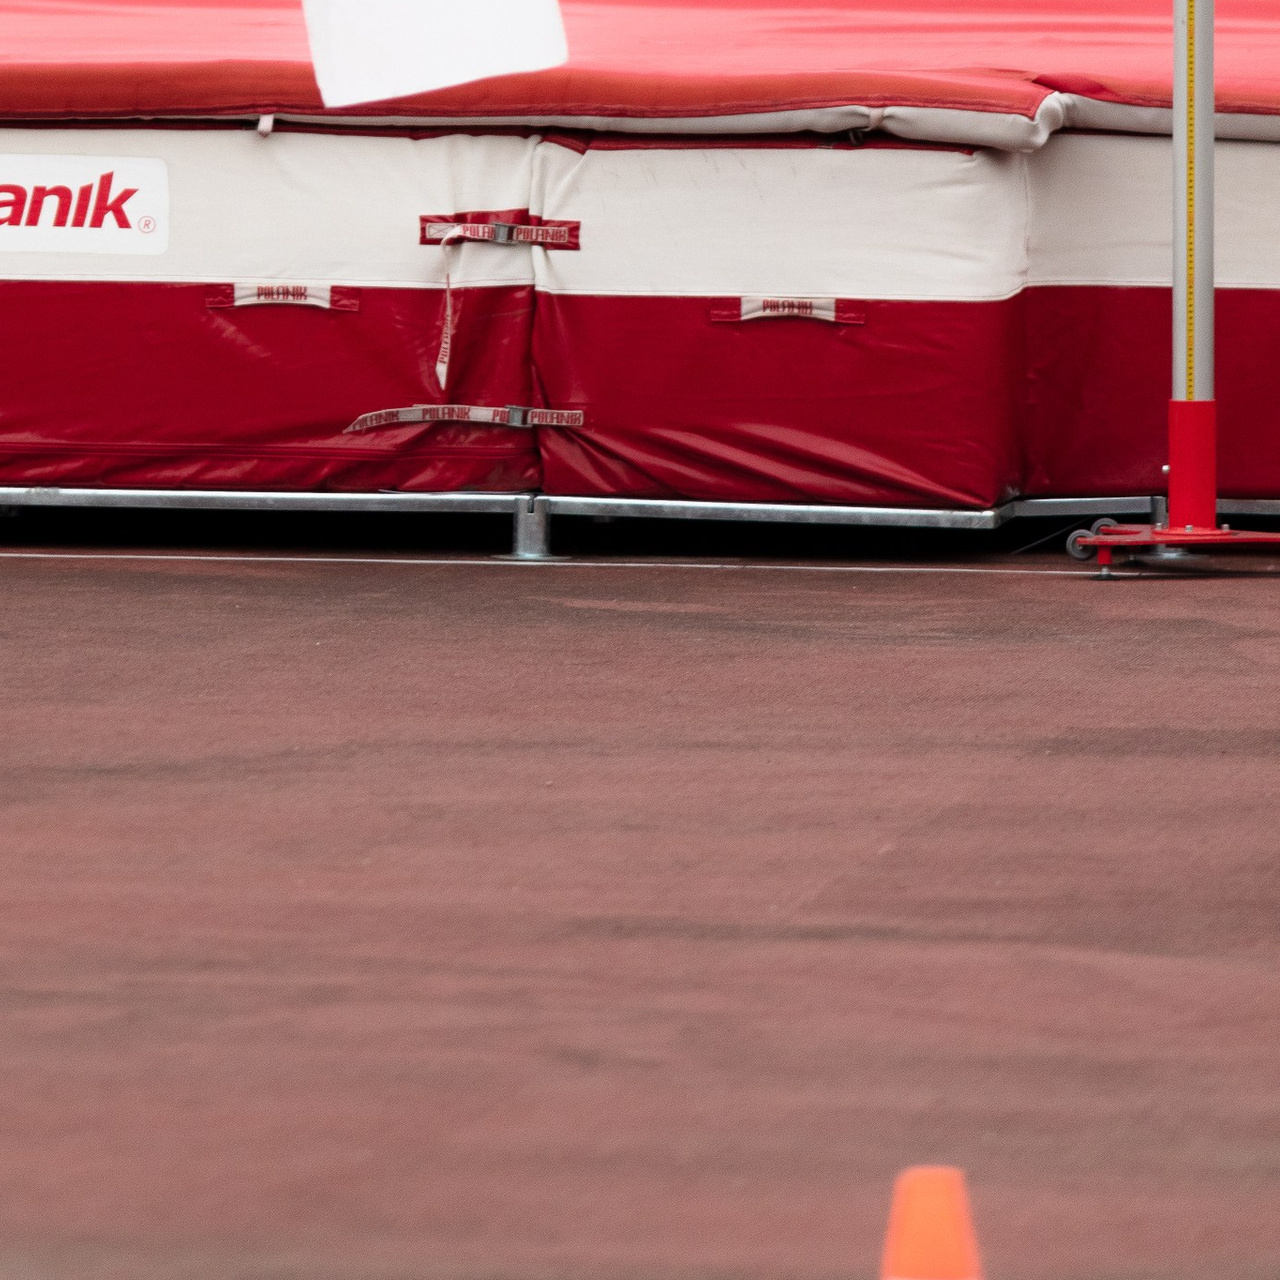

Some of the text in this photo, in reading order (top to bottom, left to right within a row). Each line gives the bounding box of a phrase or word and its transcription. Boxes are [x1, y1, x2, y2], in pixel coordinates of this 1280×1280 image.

[516, 227, 567, 241] POLANIK
[257, 285, 308, 300] POLANIK
[762, 300, 812, 314] POLANIK
[353, 410, 399, 429] POLANIK
[422, 407, 470, 420] POLANIK
[530, 410, 581, 424] POLANIK
